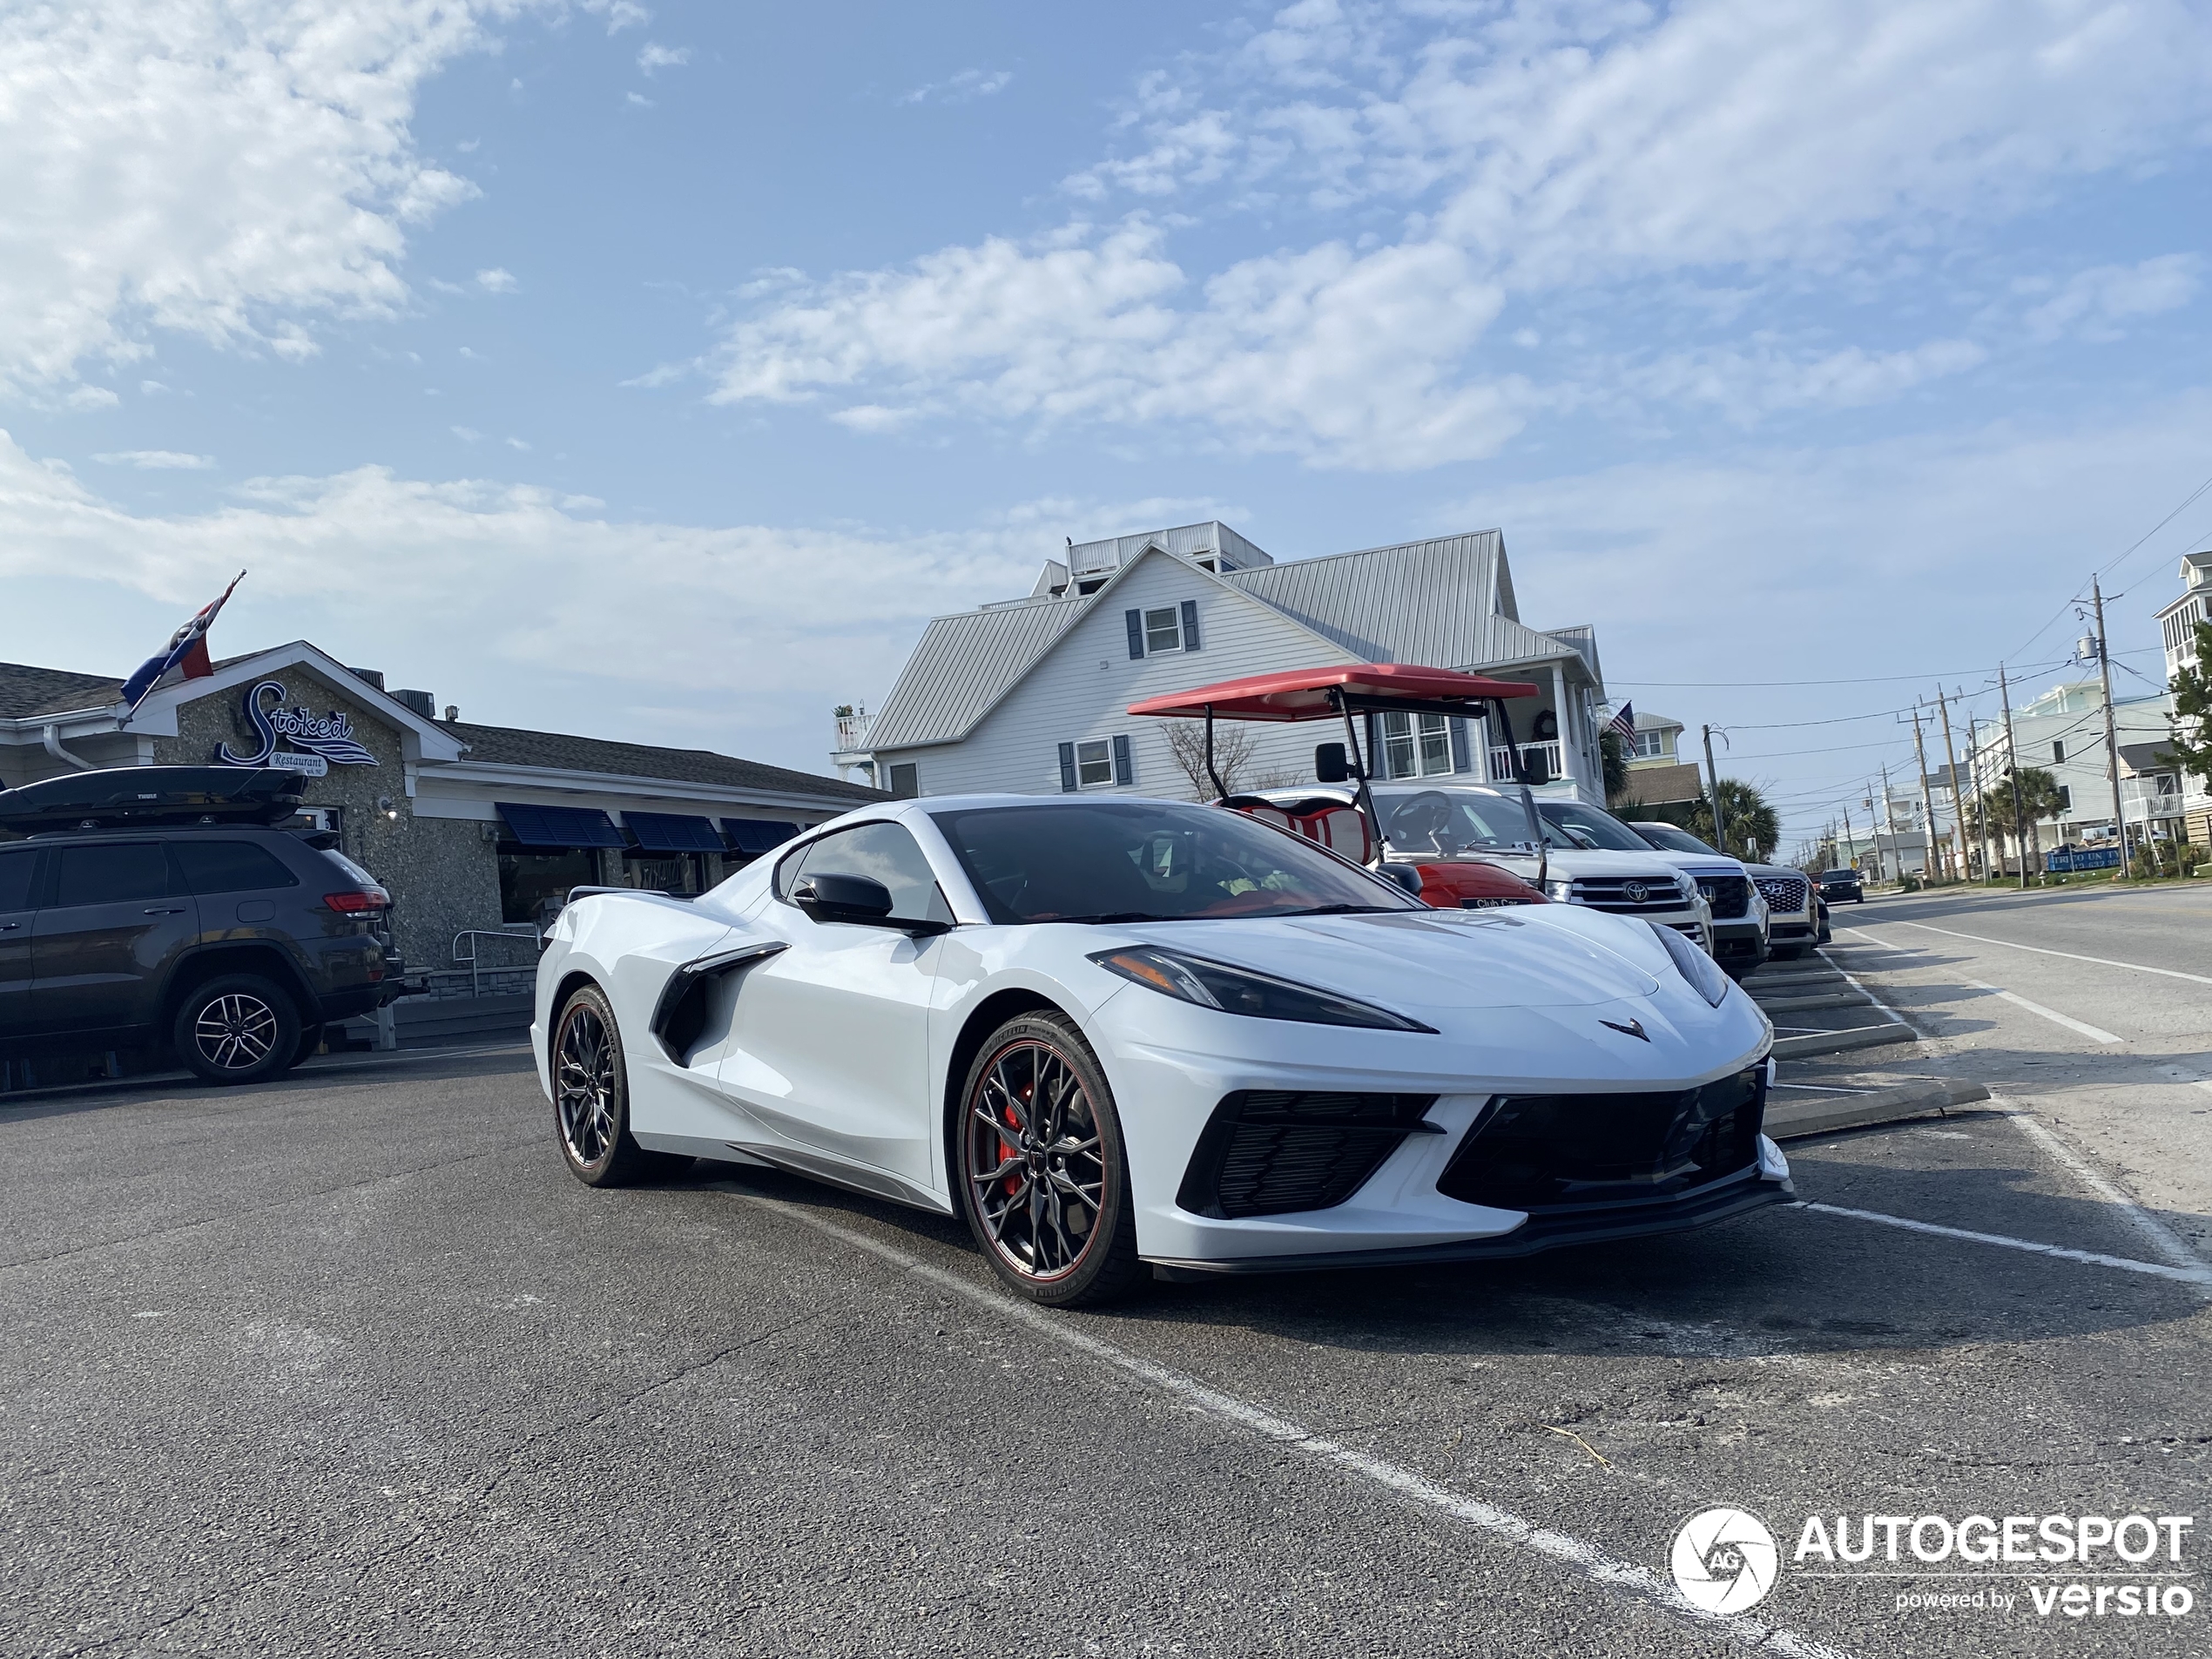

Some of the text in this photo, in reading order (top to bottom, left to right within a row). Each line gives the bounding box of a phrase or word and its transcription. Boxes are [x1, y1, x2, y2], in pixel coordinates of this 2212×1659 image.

[221, 680, 354, 765] Stoked
[273, 753, 322, 767] Restaurant
[1477, 899, 1499, 908] Club
[990, 1025, 1028, 1046] MICHELIN
